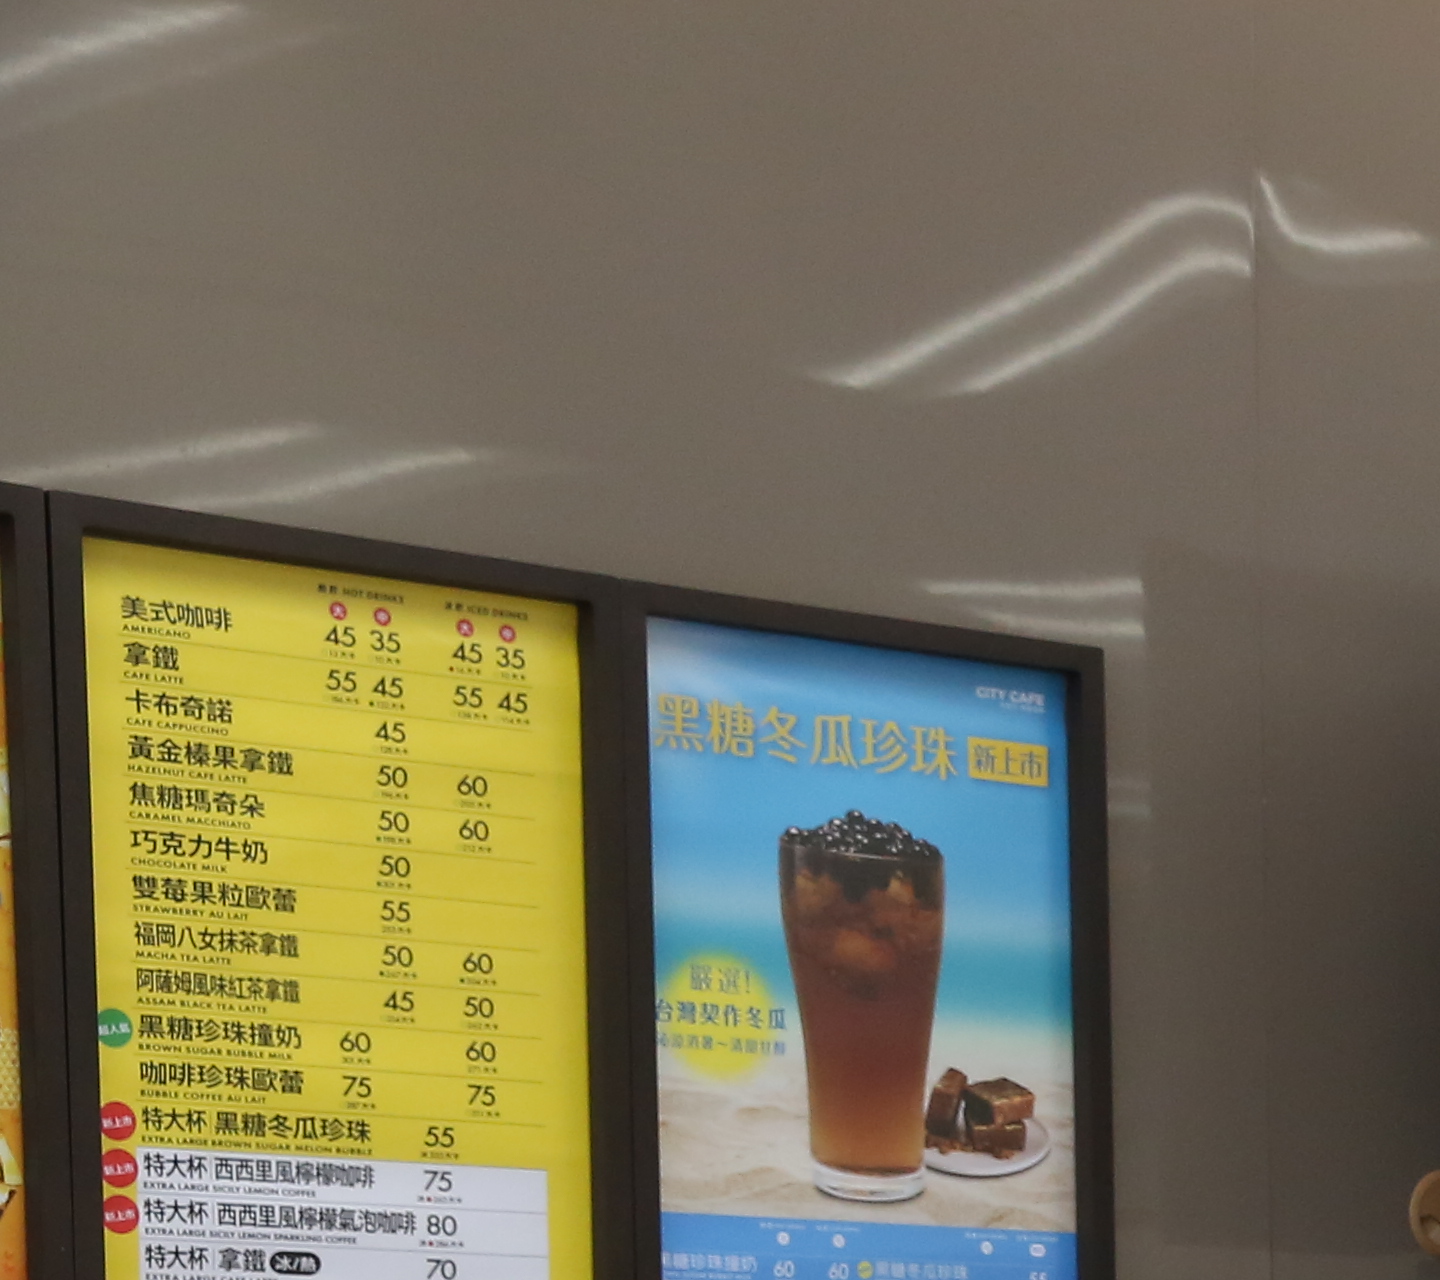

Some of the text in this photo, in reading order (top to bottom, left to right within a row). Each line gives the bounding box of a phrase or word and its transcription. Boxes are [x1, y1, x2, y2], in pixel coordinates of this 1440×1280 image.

[121, 595, 526, 670] 美式咖啡 45 35 45 35
[122, 624, 191, 639] AMERICANO
[123, 641, 528, 714] 拿鐵 55 45 55 45
[975, 685, 1046, 706] CITY CAFE
[125, 688, 406, 743] 卡布奇諾 45
[157, 720, 229, 736] CAPPUCCINO
[653, 693, 958, 781] 黑糖冬瓜珍珠
[128, 734, 488, 798] 黃金榛果拿鐵 50 60
[129, 781, 489, 842] 焦糖瑪奇朵 50 60
[186, 816, 251, 830] MACCHIATO
[130, 830, 411, 878] 巧克力牛奶 50
[131, 857, 197, 871] CHOCOLATE
[132, 874, 411, 923] 雙莓果粒歐蕾 55
[134, 921, 493, 975] 福岡八女抹茶拿鐵 50 60
[383, 991, 415, 1012] 45
[463, 996, 494, 1019] 50
[138, 1014, 496, 1063] 黑糖珍珠撞奶 60 60
[139, 1061, 496, 1107] 咖啡珍珠歐蕾 75 75
[142, 1106, 455, 1148] 特大杯 黑糖冬瓜珍珠 55
[143, 1152, 208, 1182] 特大杯
[423, 1170, 452, 1193] 75
[144, 1198, 208, 1227] 特大杯
[427, 1214, 458, 1237] 80
[145, 1244, 457, 1280] 特大杯 拿鐵 70
[773, 1260, 795, 1279] 60
[828, 1263, 850, 1280] 60
